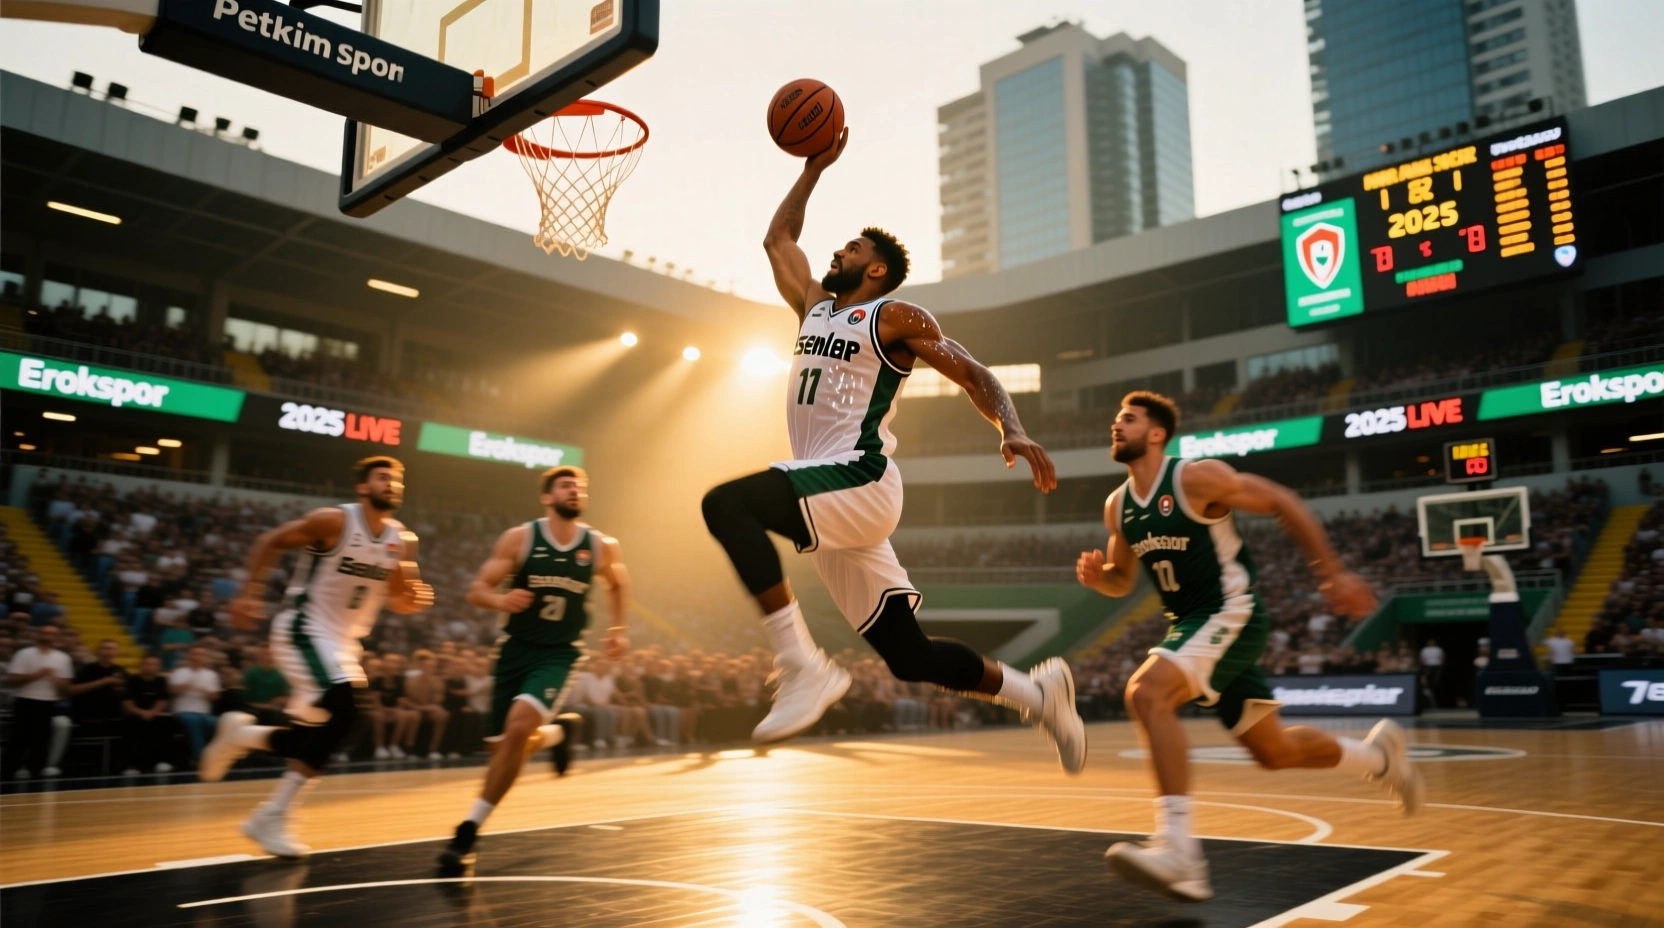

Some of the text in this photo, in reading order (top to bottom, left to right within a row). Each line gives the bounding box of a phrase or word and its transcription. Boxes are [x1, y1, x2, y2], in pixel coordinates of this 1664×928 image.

[213, 0, 331, 59] Petkim
[1388, 200, 1459, 239] 2025
[18, 357, 170, 408] Erokspor
[1540, 371, 1664, 408] Erokspo
